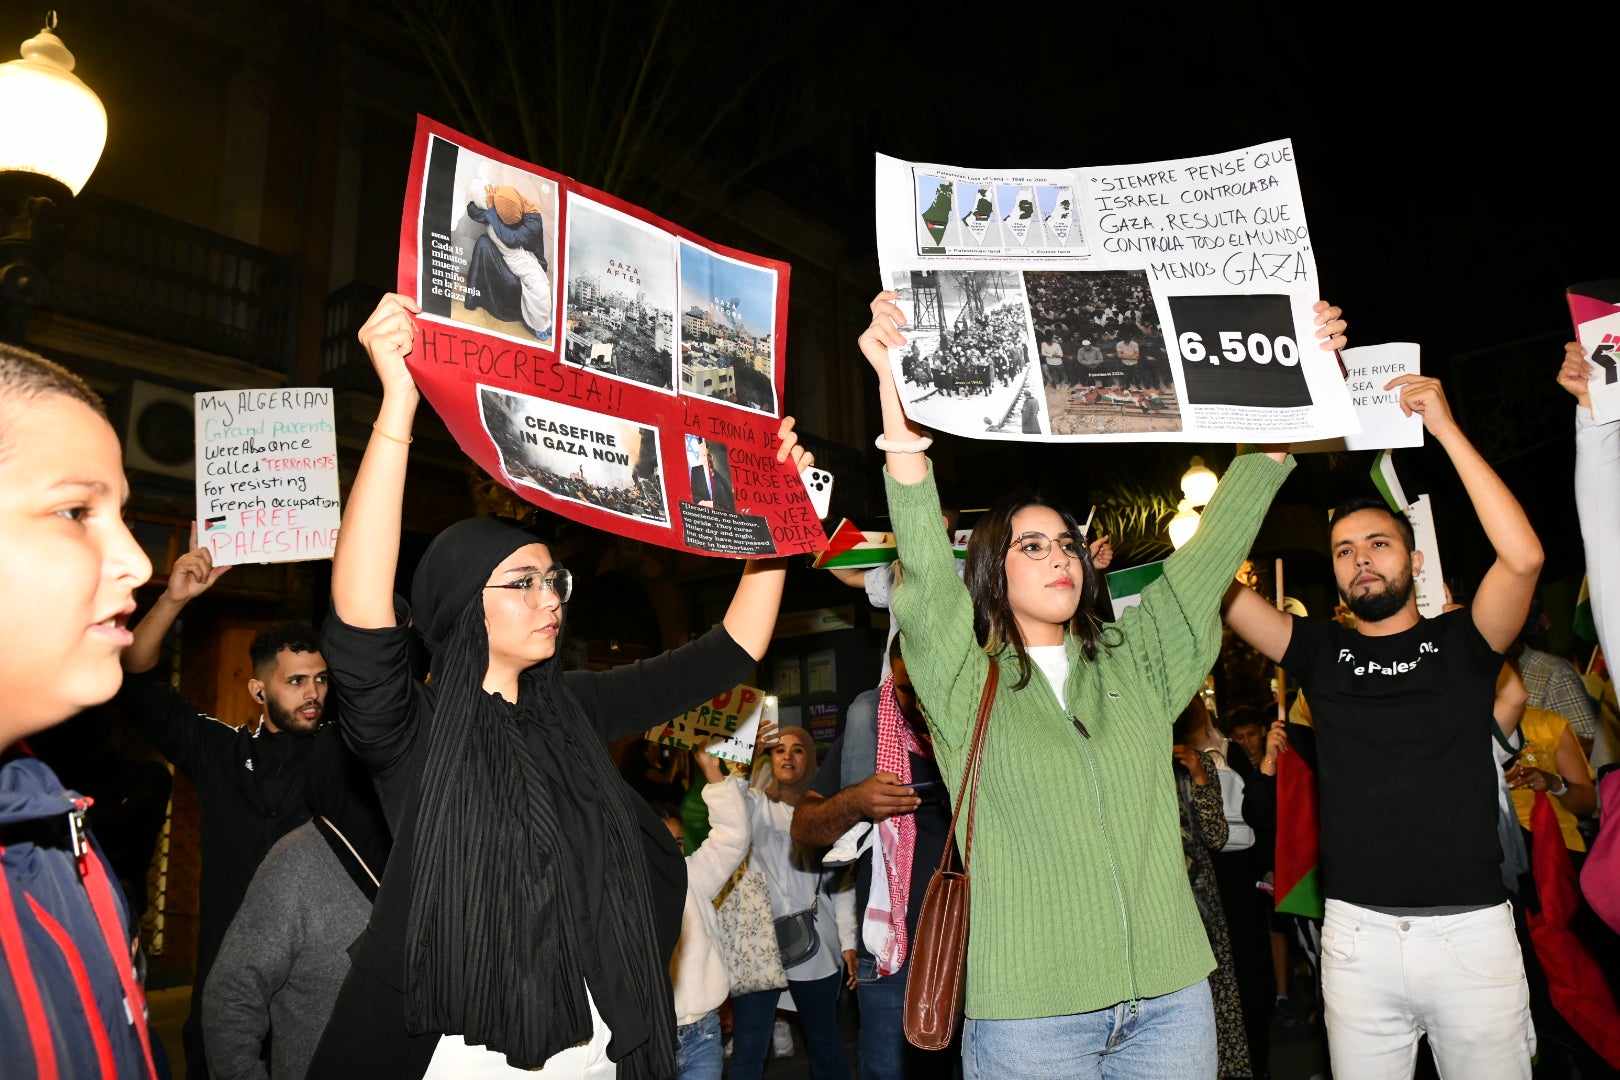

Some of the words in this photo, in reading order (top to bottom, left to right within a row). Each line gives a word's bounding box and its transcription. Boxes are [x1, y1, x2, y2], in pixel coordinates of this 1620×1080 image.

[1253, 146, 1293, 169] QUE
[1094, 193, 1170, 212] ISRAEL
[1180, 174, 1279, 204] CONTROLABA
[1166, 208, 1248, 231] RESULTA
[1253, 204, 1291, 226] QUE
[431, 239, 454, 253] Cada
[454, 246, 464, 256] 15
[1103, 235, 1185, 253] CONTROLA
[1186, 234, 1226, 250] TODO
[1229, 232, 1245, 247] EL
[1245, 225, 1309, 246] MUNDO
[431, 249, 468, 266] minutos
[431, 259, 460, 273] muere
[432, 268, 444, 277] un
[445, 271, 465, 283] niño
[609, 259, 639, 275] GAZA
[1150, 261, 1217, 281] MENOS
[606, 267, 641, 286] AFTER
[431, 285, 443, 296] de
[444, 288, 466, 302] Gaza
[432, 277, 444, 286] en
[444, 279, 453, 289] la
[453, 281, 481, 297] Franja
[709, 302, 742, 320] BEFORE
[714, 297, 738, 311] GAZA
[1178, 331, 1299, 367] 6,500
[1372, 363, 1406, 374] RIVER
[1352, 381, 1374, 391] SEA
[1372, 393, 1400, 404] WILL
[201, 396, 234, 427] My
[205, 418, 265, 442] Grand
[273, 419, 334, 439] parents
[524, 415, 616, 447] CEASEFIRE
[684, 410, 700, 430] LA
[708, 417, 755, 443] IRONÍA
[763, 431, 777, 449] DE
[519, 430, 538, 446] IN
[543, 437, 588, 458] GAZA
[592, 447, 629, 467] NOW
[230, 476, 307, 492] resisting
[730, 465, 782, 489] TIRSE
[783, 474, 802, 488] EN
[210, 496, 266, 512] French
[735, 487, 748, 502] LO
[753, 491, 782, 505] QUE
[240, 508, 298, 529] FREE
[711, 509, 728, 517] have
[774, 507, 811, 525] VEZ
[685, 523, 704, 532] Hitler
[705, 528, 719, 536] day
[686, 529, 697, 537] but
[698, 533, 713, 541] they
[715, 523, 732, 532] They
[686, 536, 706, 546] Hitler
[792, 540, 817, 553] TE
[1338, 648, 1366, 676] Fre
